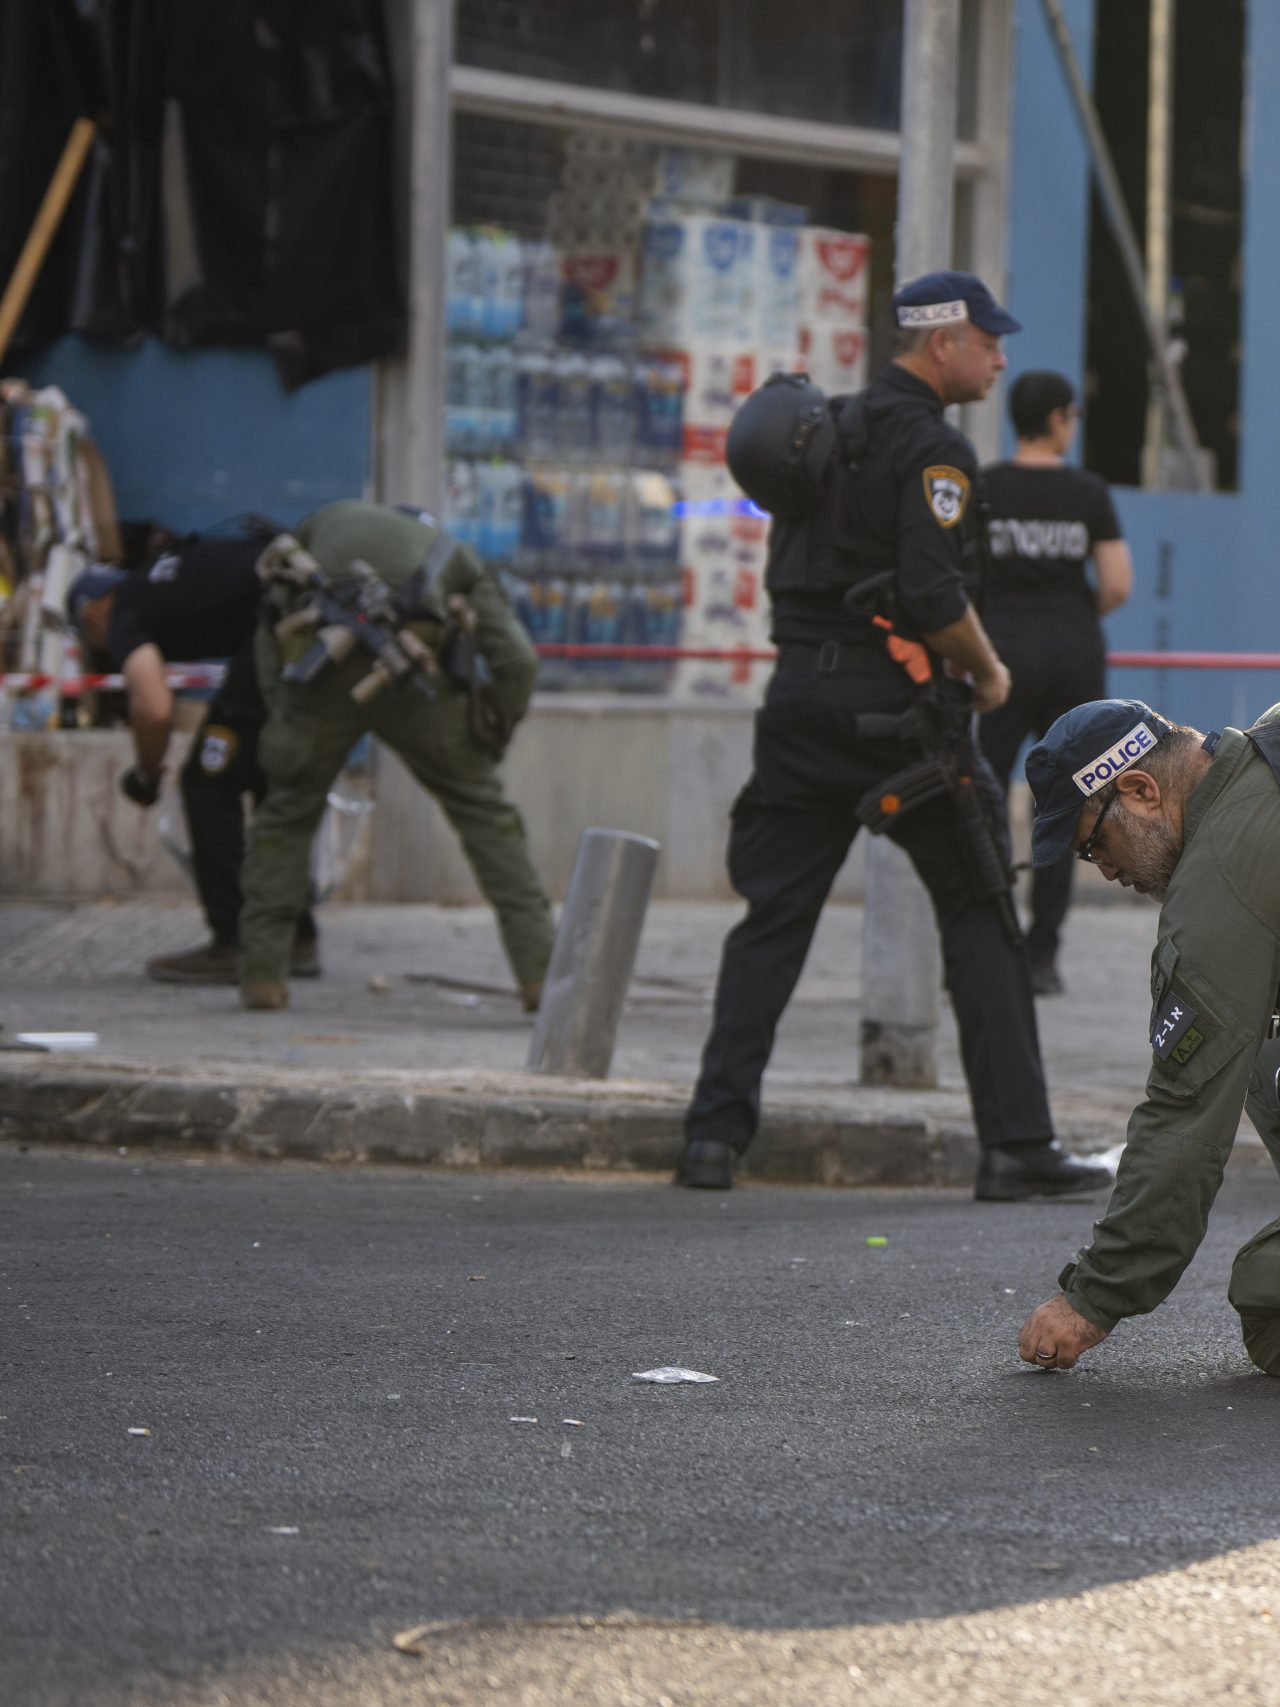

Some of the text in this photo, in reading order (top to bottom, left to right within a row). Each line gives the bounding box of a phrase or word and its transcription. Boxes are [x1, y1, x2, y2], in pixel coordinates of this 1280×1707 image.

[901, 304, 960, 321] POLICE
[988, 519, 1088, 559] משטרה
[1081, 730, 1152, 790] POLICE
